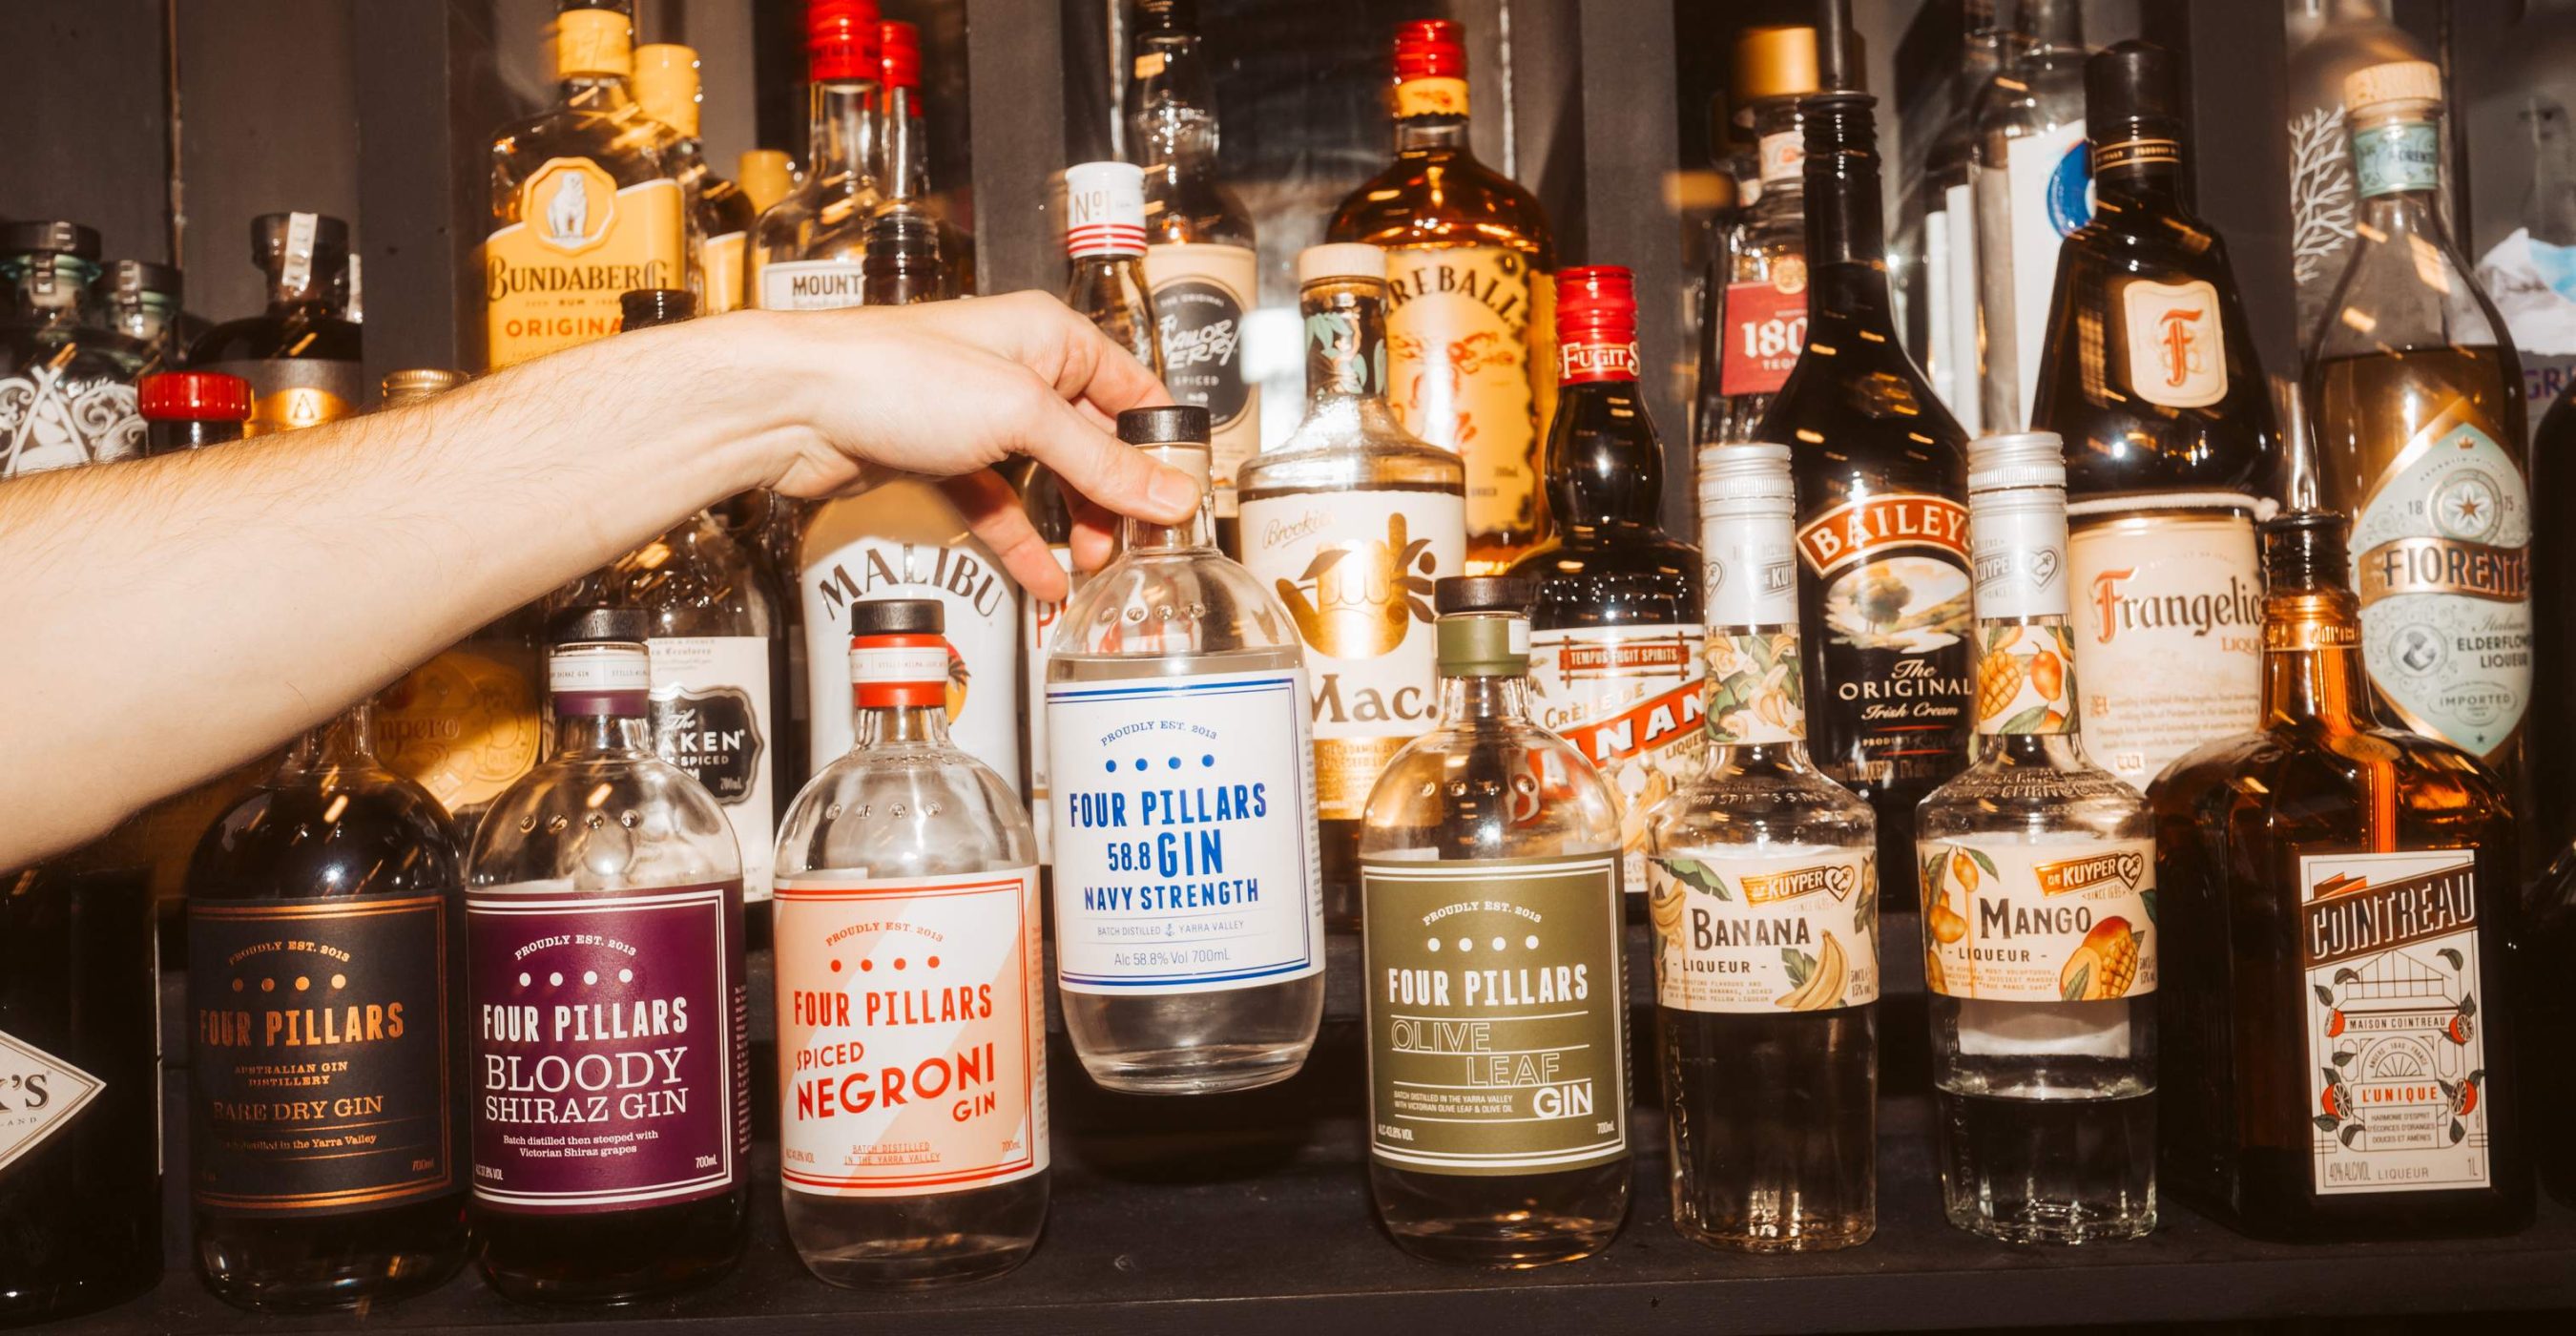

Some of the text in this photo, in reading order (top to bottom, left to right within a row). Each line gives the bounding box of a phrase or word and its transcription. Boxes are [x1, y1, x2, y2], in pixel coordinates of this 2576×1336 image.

[488, 256, 667, 302] BUNDABERG
[793, 275, 861, 296] MOUNT
[1387, 265, 1520, 324] REBALL
[506, 320, 622, 337] ORIGINA
[1741, 316, 1808, 359] 180
[2408, 501, 2423, 515] 18
[820, 543, 1003, 620] MALIBU
[2093, 566, 2261, 644] Frangelic
[1642, 648, 1677, 661] SPIRITS
[1891, 658, 1936, 680] The
[1312, 674, 1437, 722] Mac.
[1839, 678, 1972, 700] ORIGINAL
[2440, 694, 2510, 707] IMPORTED
[1861, 701, 1959, 720] Irish Cream
[657, 730, 740, 757] AKEN
[1101, 720, 1154, 747] PROUDLY
[1191, 724, 1218, 741] 2013
[681, 755, 729, 766] SPICED
[1070, 783, 1267, 827] FOUR PILLARS
[1108, 828, 1223, 878] 58.8 GIN
[1767, 869, 1823, 897] KUYPER
[2063, 858, 2116, 887] KUYPER
[1084, 878, 1258, 910] NAVY STRENGTH
[1423, 900, 1542, 927] PROUDLY EST. 2013
[1979, 898, 2091, 939] MANGO
[2313, 872, 2475, 960] COINTREAU
[825, 922, 880, 947] PROUDLY
[916, 927, 944, 943] 2013
[1097, 920, 1244, 936] BATCH DISTILLED YARRA VALLEY
[1692, 908, 1810, 950] BANANA
[288, 941, 317, 952] EST.
[320, 945, 350, 962] 2013
[514, 934, 636, 960] PROUDLY EST. 2013
[1114, 949, 1231, 966] Alc 58.8% Vol 700mL
[1959, 948, 2030, 962] LIQUEUR
[1683, 960, 1751, 972] LIQUEUR
[1388, 964, 1588, 1006] FOUR PILLARS
[794, 984, 992, 1027] FOUR PILLARS
[199, 1002, 404, 1047] FOUR PILLARS
[484, 996, 688, 1042] FOUR PILLARS
[2350, 1015, 2446, 1030] MAISON COINTREAU
[1391, 1020, 1491, 1054] OLIVE
[322, 1061, 348, 1073] GIN
[797, 1041, 864, 1071] SPICED
[485, 1047, 688, 1092] BLOODY
[798, 1042, 994, 1121] NEGRONI
[1466, 1053, 1560, 1087] LEAF
[486, 1088, 689, 1123] SHIRAZ GIN
[953, 1092, 995, 1122] GIN
[1448, 1095, 1461, 1103] THE
[1487, 1095, 1513, 1103] VALLEY
[1533, 1083, 1593, 1118] GIN
[2362, 1086, 2438, 1103] L'UNIQUE
[213, 1096, 384, 1121] RARE DRY GIN
[293, 1139, 309, 1149] the
[312, 1138, 343, 1148] Yarra
[344, 1134, 377, 1145] Valley
[503, 1130, 658, 1146] Batch distilled then steeped with
[853, 1141, 930, 1154] BATCH DISTILLED
[519, 1145, 636, 1158] Victorian Shiraz grapes
[696, 1155, 717, 1169] 700mL
[859, 1155, 873, 1165] THE
[878, 1154, 904, 1164] YARRA
[909, 1153, 941, 1163] VALLEY
[2379, 1167, 2428, 1179] LIQUEUR
[2468, 1157, 2478, 1176] 1L
